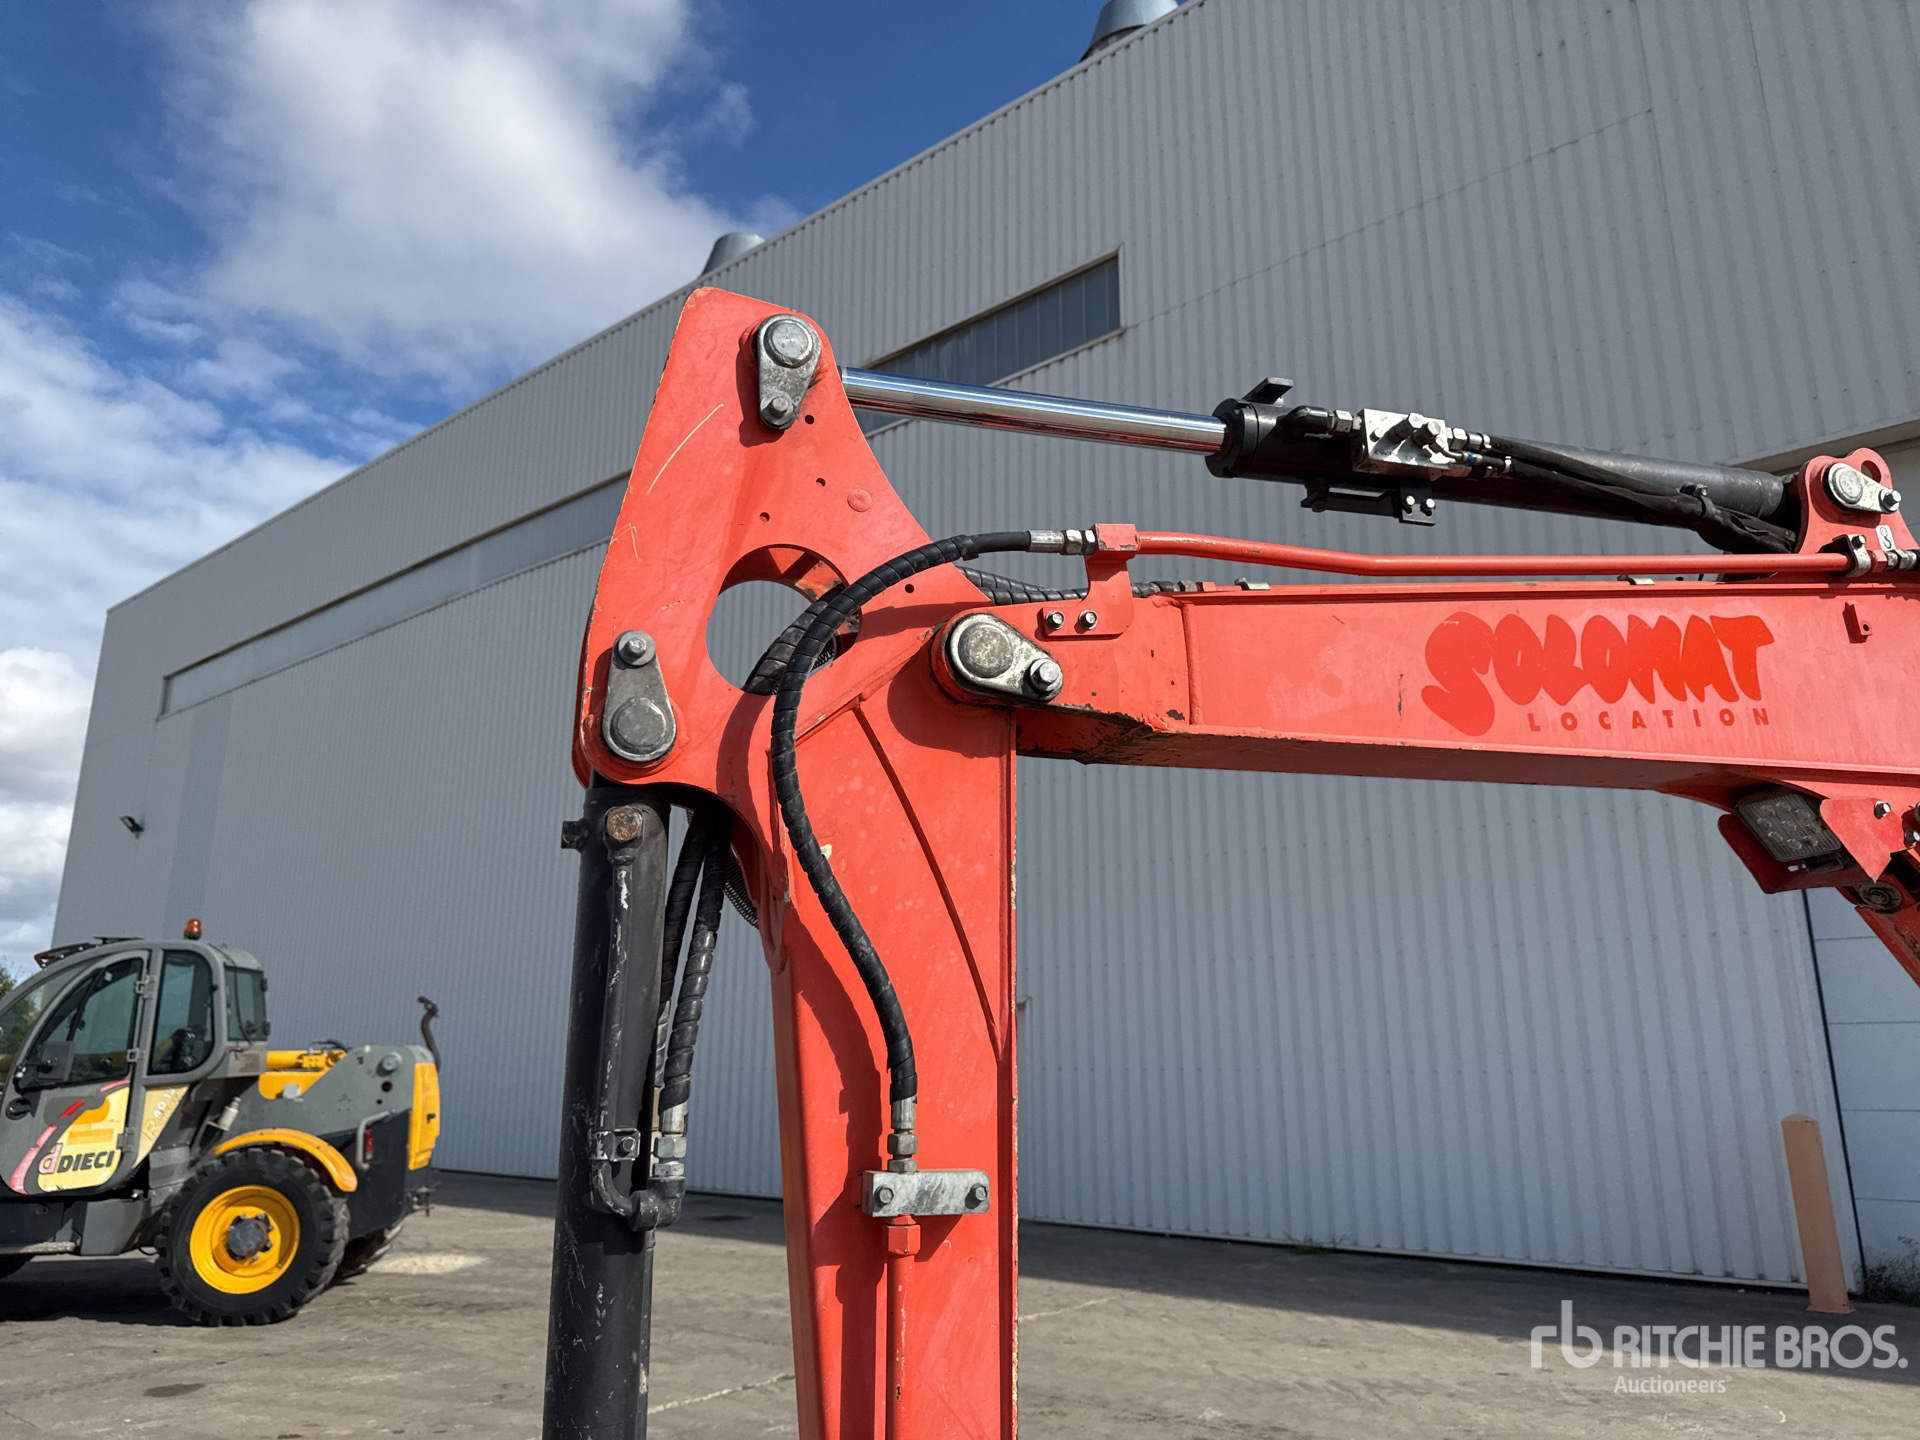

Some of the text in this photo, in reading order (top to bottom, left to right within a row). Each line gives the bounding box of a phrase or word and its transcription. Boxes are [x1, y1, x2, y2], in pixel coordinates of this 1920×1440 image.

[1421, 611, 1774, 736] SOLOMAT
[1528, 708, 1770, 732] LOCATION
[57, 1151, 115, 1174] DIECI
